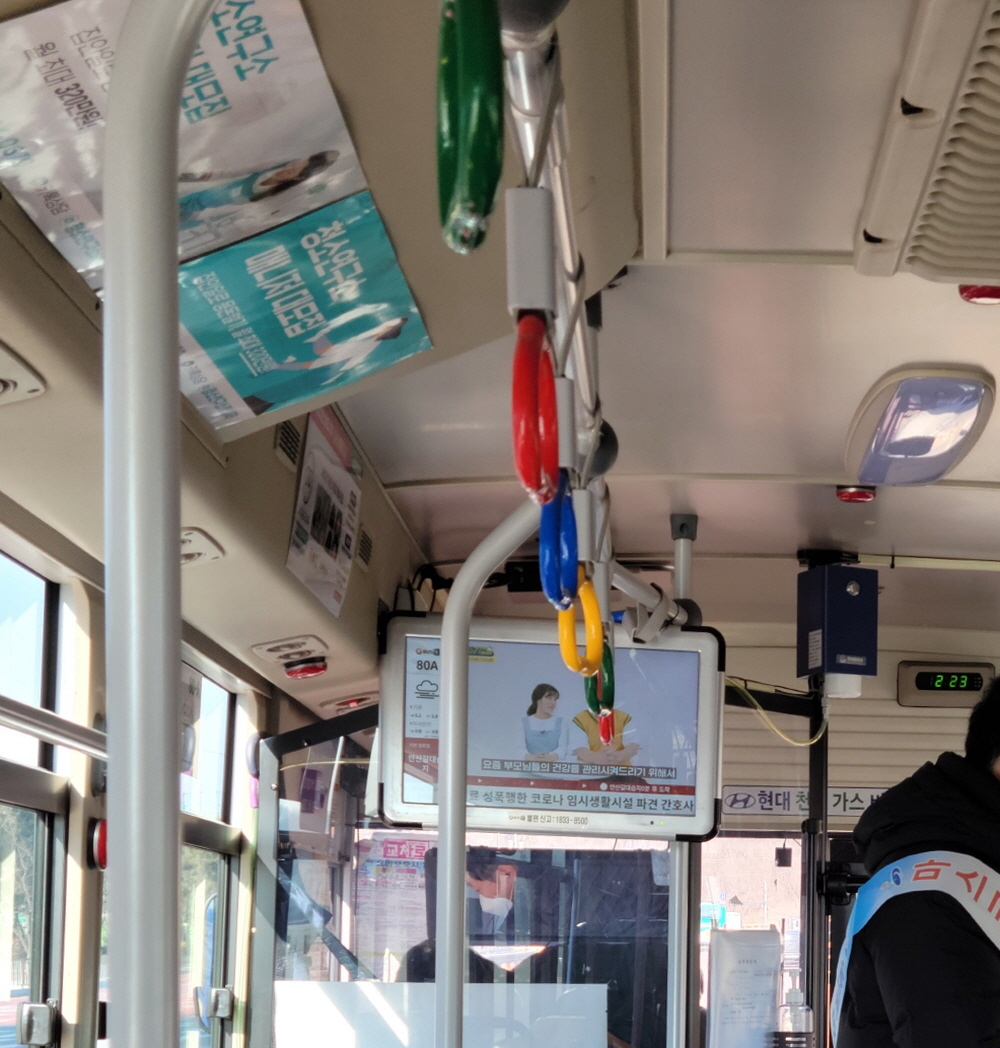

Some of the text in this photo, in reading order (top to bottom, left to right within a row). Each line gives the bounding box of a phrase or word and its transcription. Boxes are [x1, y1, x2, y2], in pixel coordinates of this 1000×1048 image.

[35, 57, 77, 87] 최대
[300, 220, 368, 304] 청소연구소
[244, 244, 328, 339] 매니저 대모집
[416, 660, 438, 671] 80A
[408, 754, 439, 764] 안산갈대
[482, 759, 677, 779] 요즘 부모님들의 건강을 관리시켜드리기 위해서
[482, 790, 528, 803] 성폭행한
[530, 793, 564, 806] 코로나
[566, 795, 634, 810] 임시생활시설
[636, 797, 659, 811] 파견
[661, 799, 695, 813] 간호사
[757, 790, 791, 811] 현대
[832, 791, 866, 813] 가스
